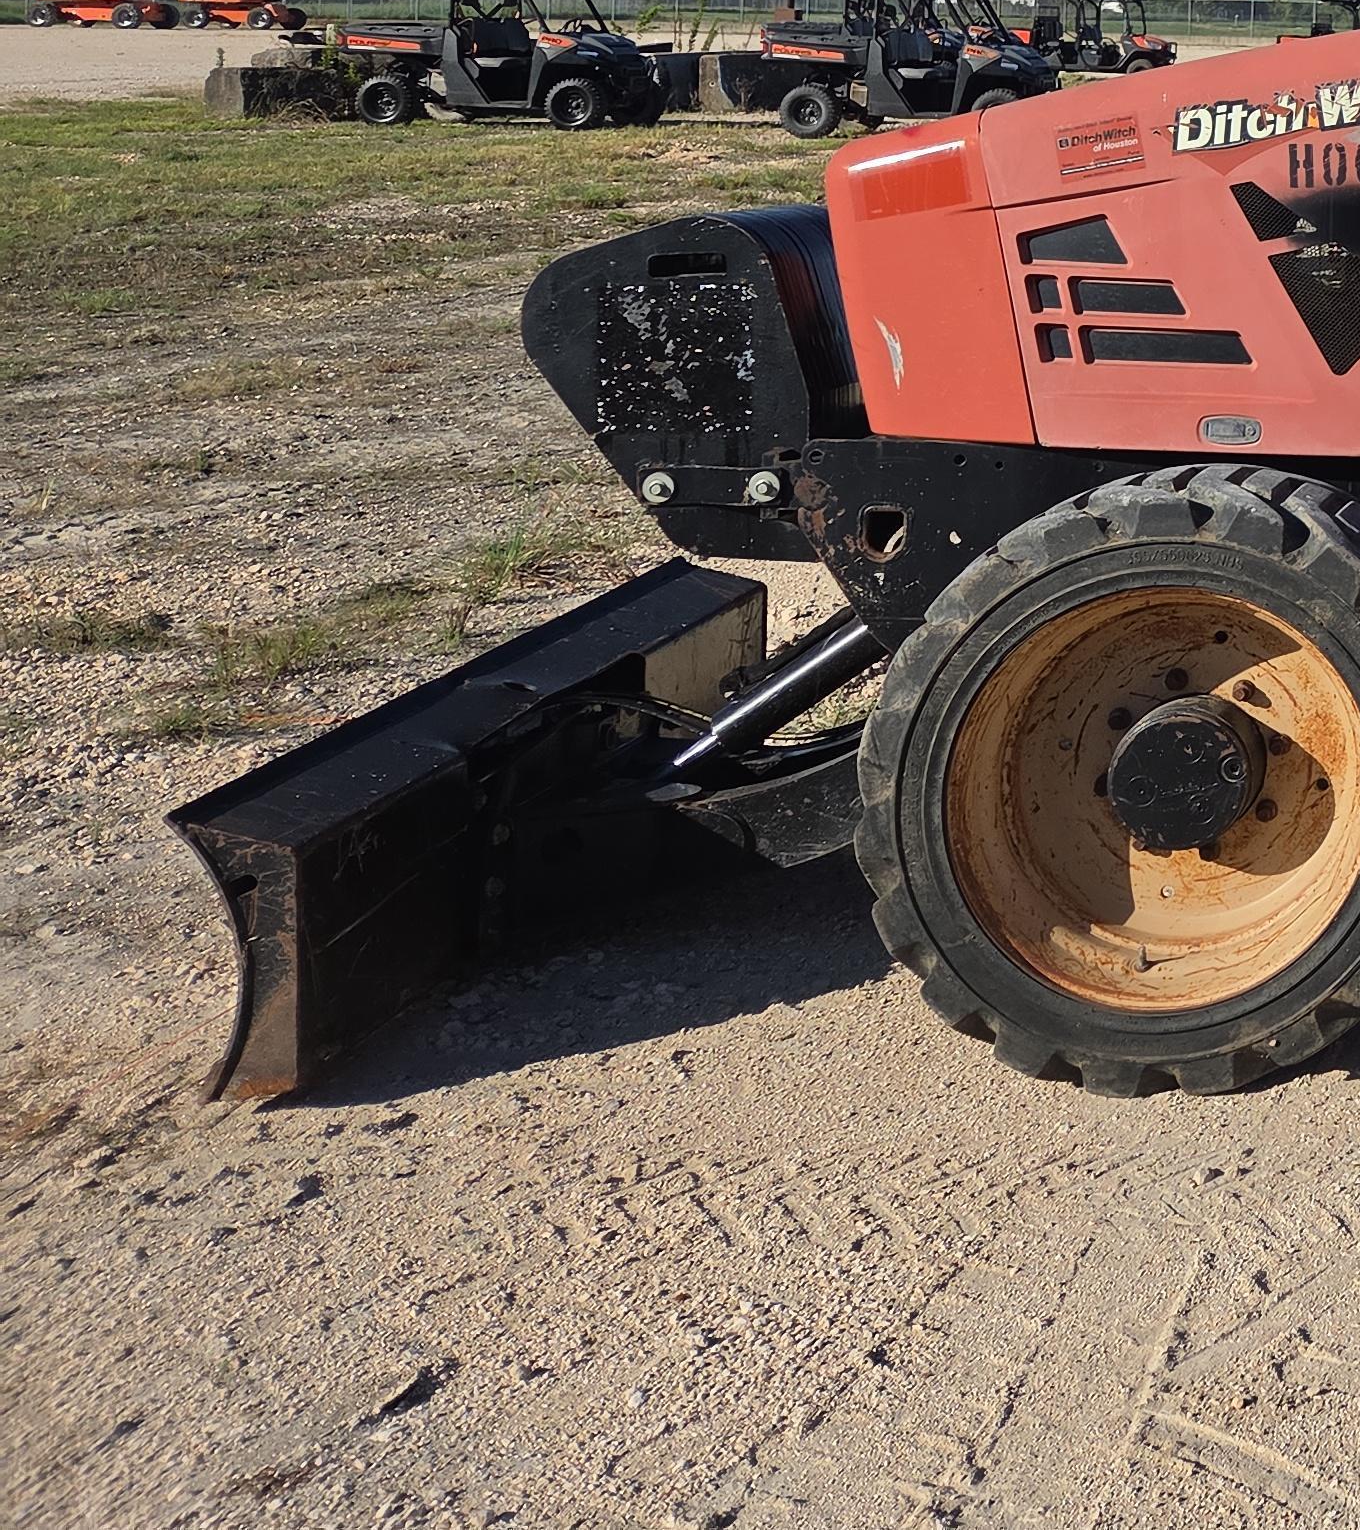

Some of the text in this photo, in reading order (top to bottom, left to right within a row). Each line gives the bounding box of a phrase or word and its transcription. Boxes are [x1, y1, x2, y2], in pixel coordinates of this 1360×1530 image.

[1176, 94, 1308, 151] Ditch
[1071, 126, 1136, 147] Ditch Witch
[1093, 138, 1138, 152] of Houston
